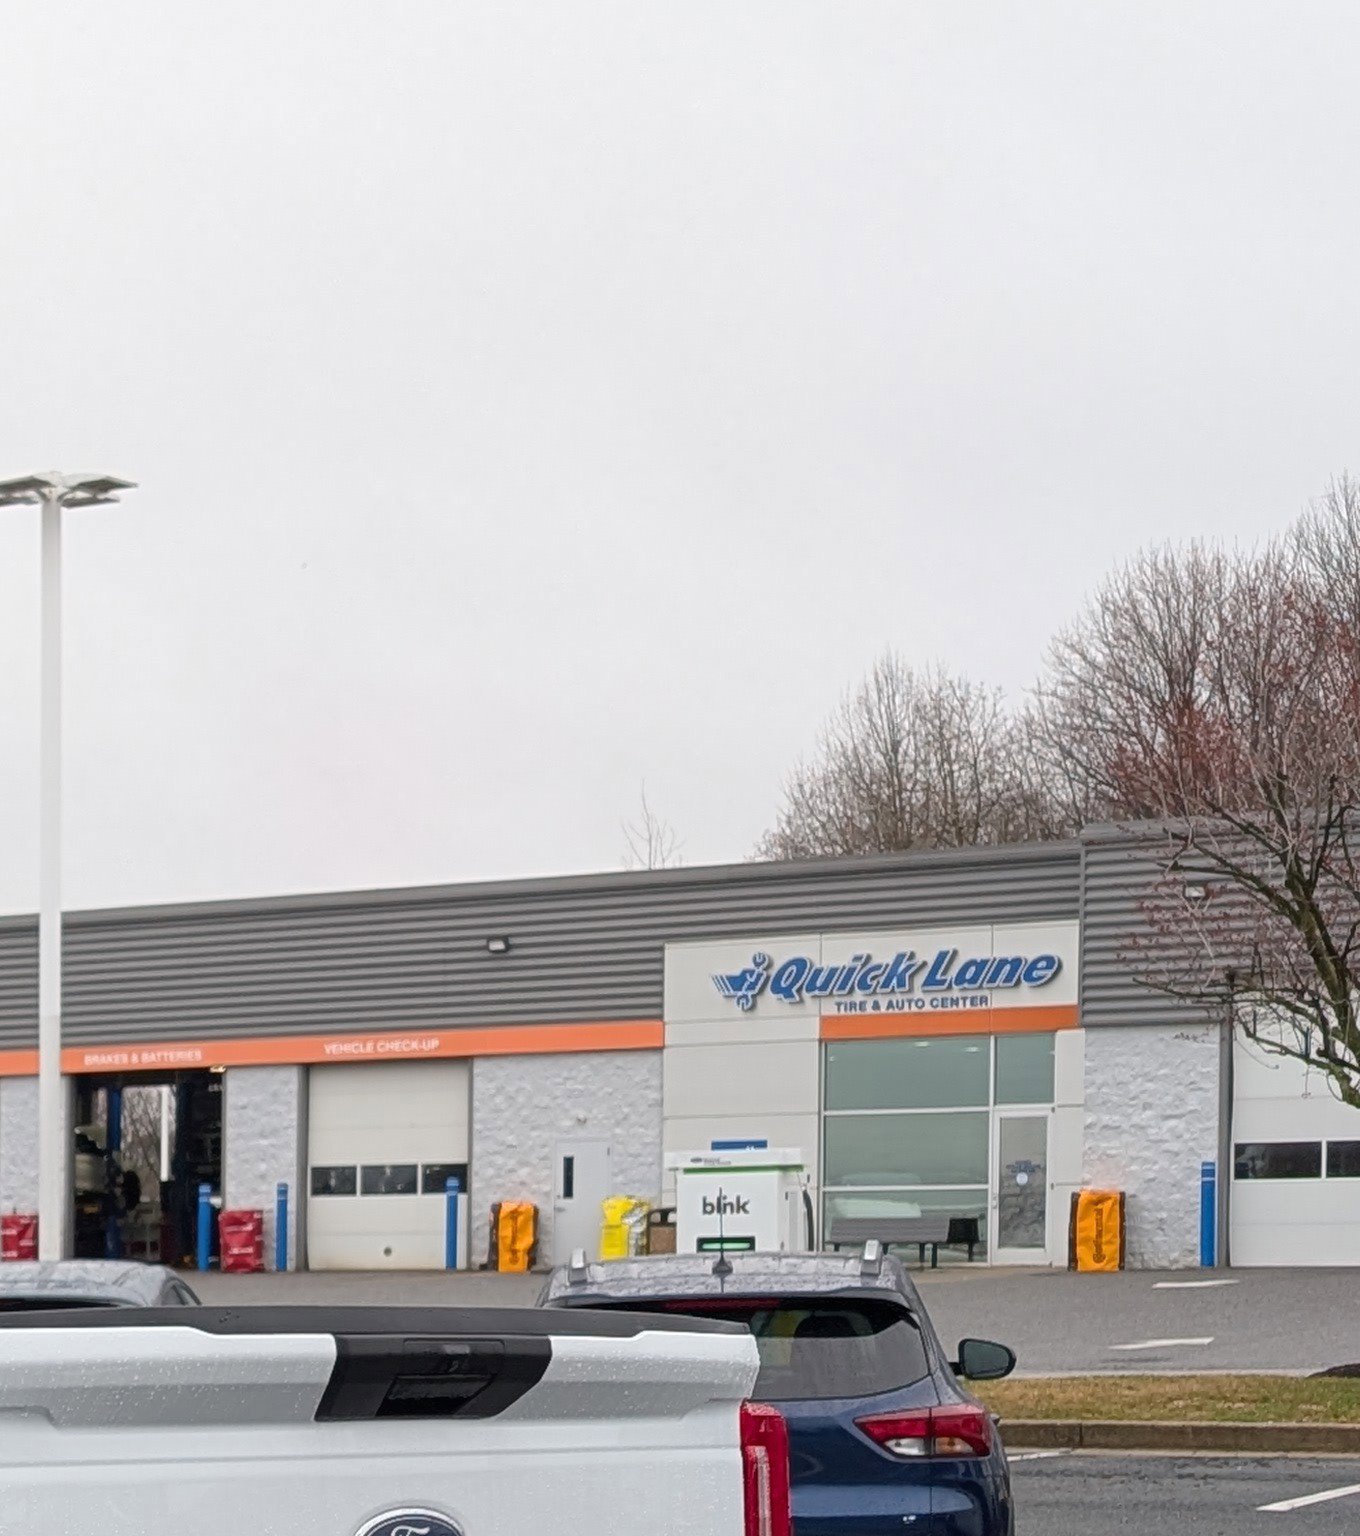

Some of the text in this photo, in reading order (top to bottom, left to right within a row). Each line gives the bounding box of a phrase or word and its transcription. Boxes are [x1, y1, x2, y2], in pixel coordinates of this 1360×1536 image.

[770, 948, 1062, 1003] Quick Lane
[835, 995, 989, 1014] TIRE & AUTO CENTER
[323, 1038, 440, 1055] VEHICLE CHECK-UP
[84, 1053, 128, 1066] BRAKES
[141, 1049, 202, 1064] BATTERIES
[702, 1195, 750, 1215] blink
